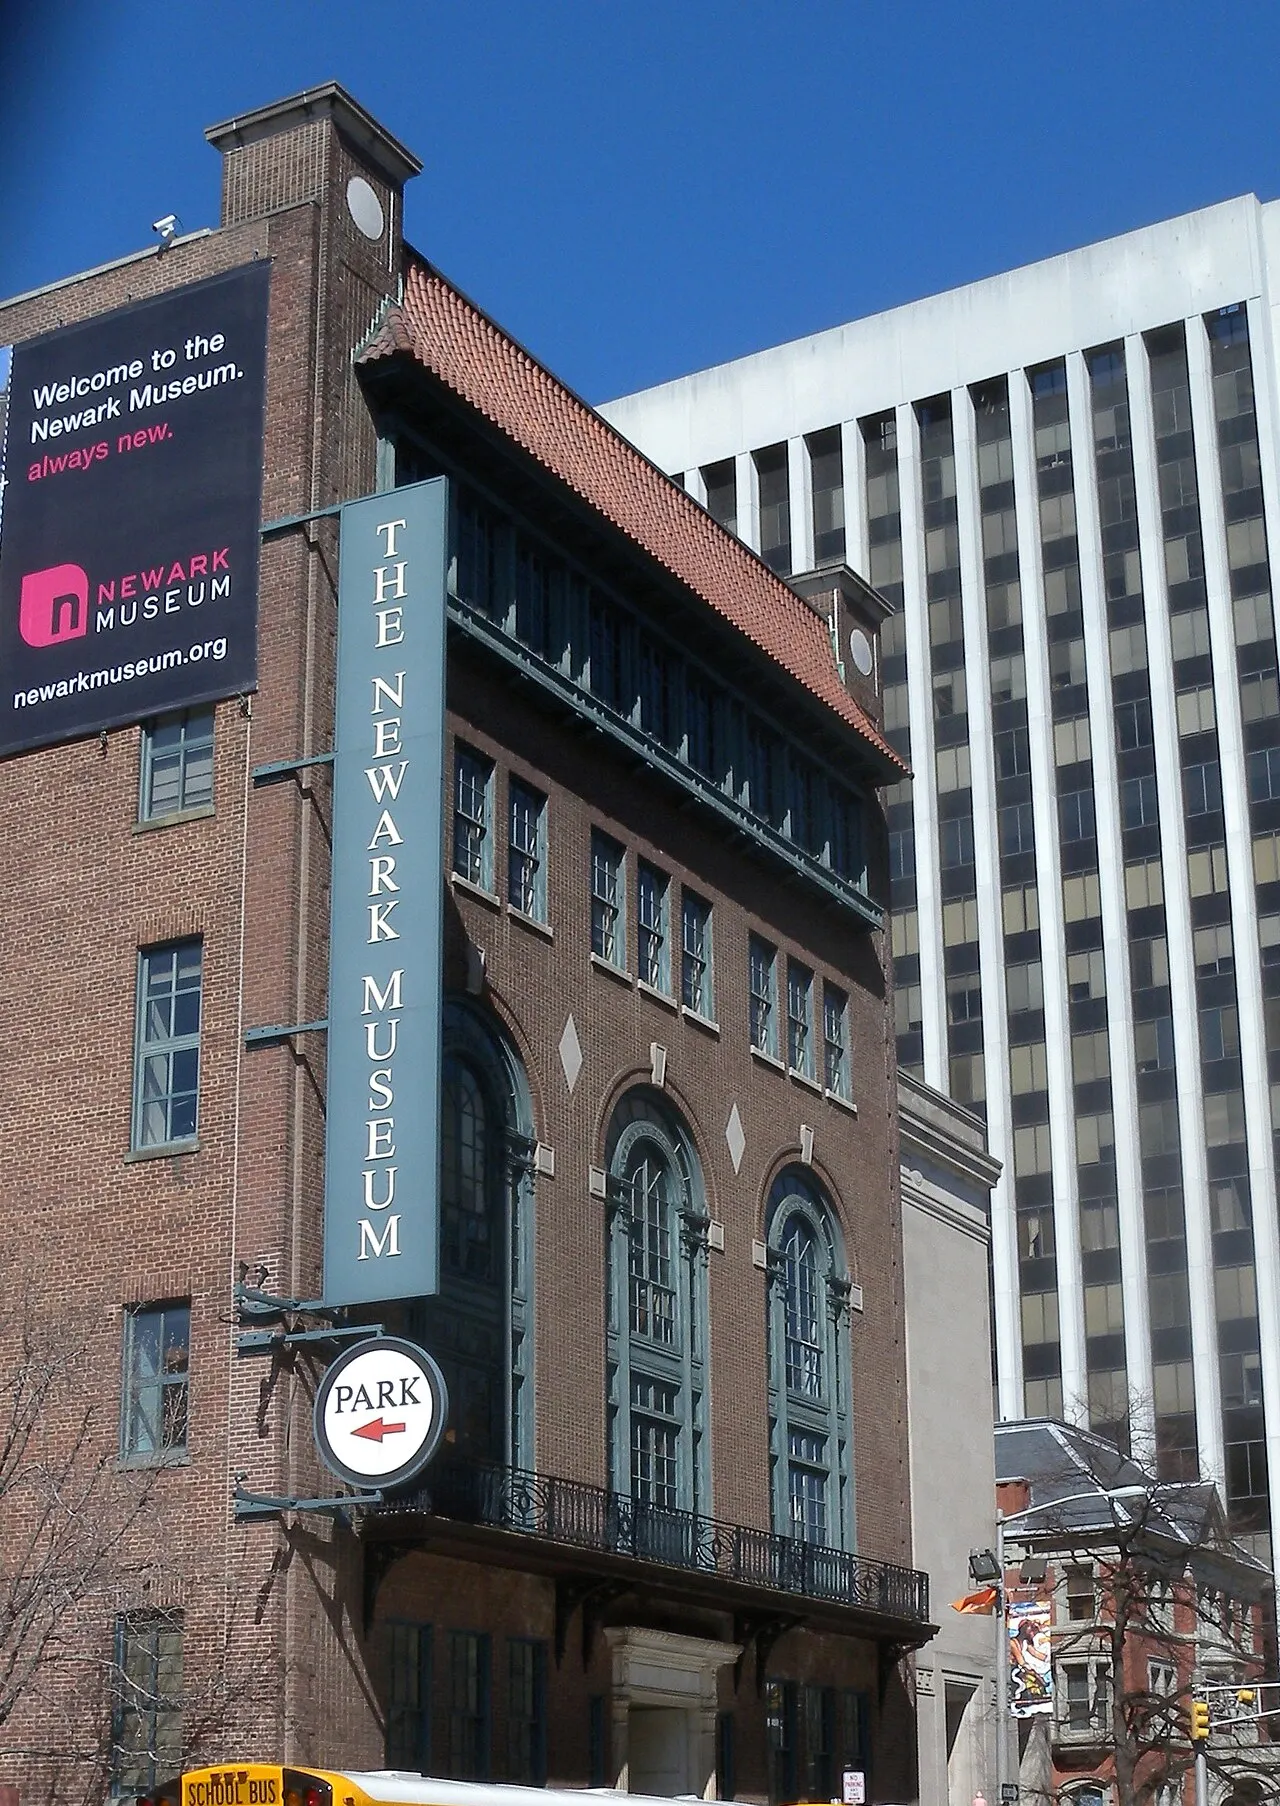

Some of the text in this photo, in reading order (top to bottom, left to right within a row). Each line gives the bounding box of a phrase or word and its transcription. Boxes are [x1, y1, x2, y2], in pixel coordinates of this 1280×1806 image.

[32, 331, 226, 411] Welcome to the
[30, 361, 245, 444] Newark Museum.
[27, 420, 174, 482] always new.
[95, 574, 231, 634] MUSEUM
[97, 547, 231, 606] NEWARK
[12, 636, 228, 710] newarkmuseum.org
[357, 518, 409, 1261] THE NEWARK MUSEUM
[334, 1376, 422, 1414] PARK
[188, 1779, 276, 1806] SCHOOL BUS
